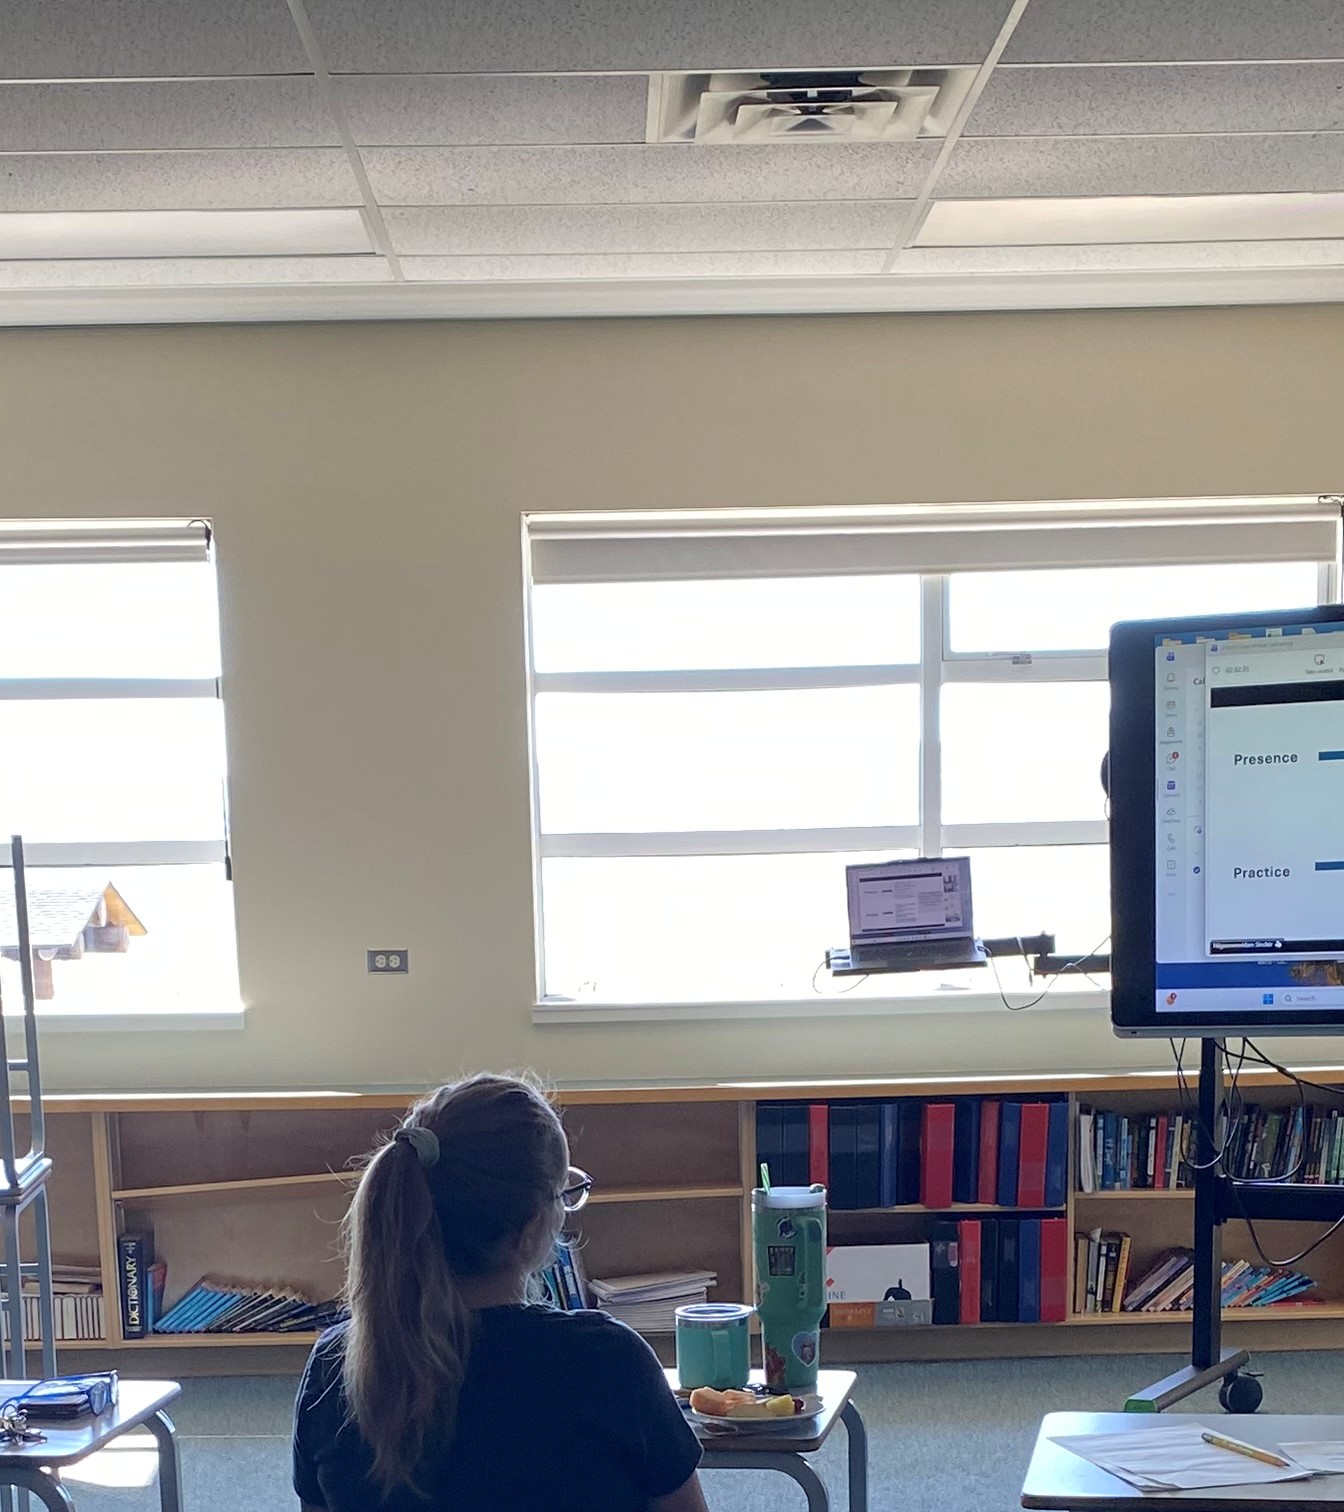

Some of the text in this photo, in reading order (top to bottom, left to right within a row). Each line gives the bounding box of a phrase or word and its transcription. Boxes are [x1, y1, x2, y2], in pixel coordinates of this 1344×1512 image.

[1233, 752, 1299, 766] Presence
[1233, 866, 1291, 879] Practice
[125, 1256, 141, 1325] DICTIONARY
